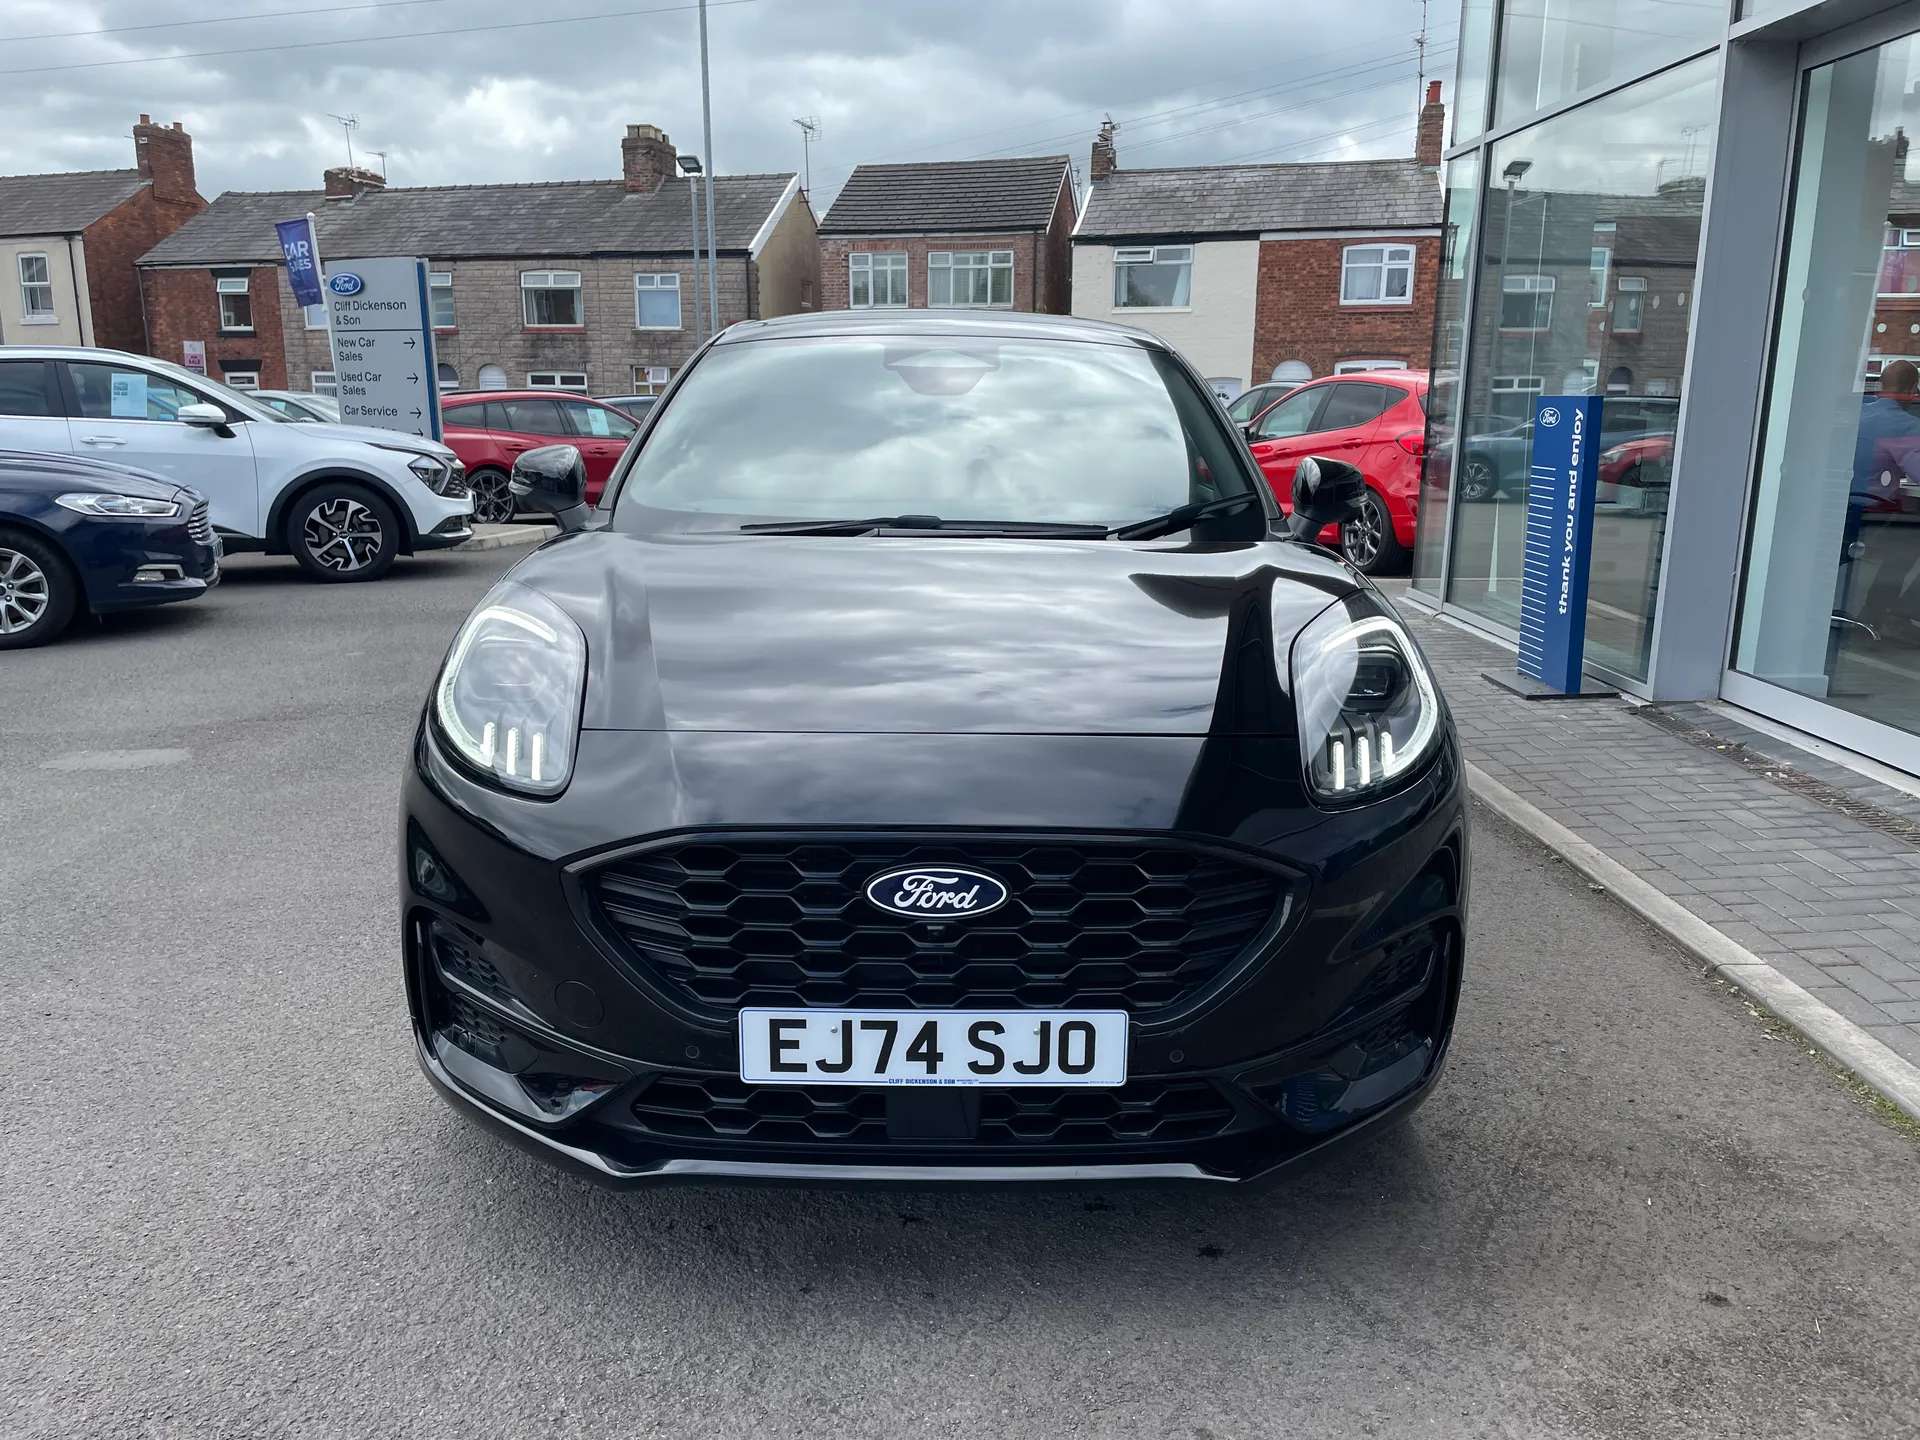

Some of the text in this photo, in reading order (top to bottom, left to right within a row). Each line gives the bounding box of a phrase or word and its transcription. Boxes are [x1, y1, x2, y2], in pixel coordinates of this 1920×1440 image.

[284, 240, 309, 260] CAR
[335, 276, 355, 291] Ford
[334, 300, 407, 312] Cliff Dickenson
[335, 314, 361, 325] & Son
[337, 337, 376, 348] New Car
[339, 351, 364, 361] Sales
[341, 371, 382, 382] Used Car
[342, 385, 367, 395] Sales
[344, 404, 398, 416] Car Service
[1559, 408, 1584, 615] thank you and enjoy
[894, 875, 980, 908] Ford
[769, 1019, 1096, 1075] EJ74 SJO
